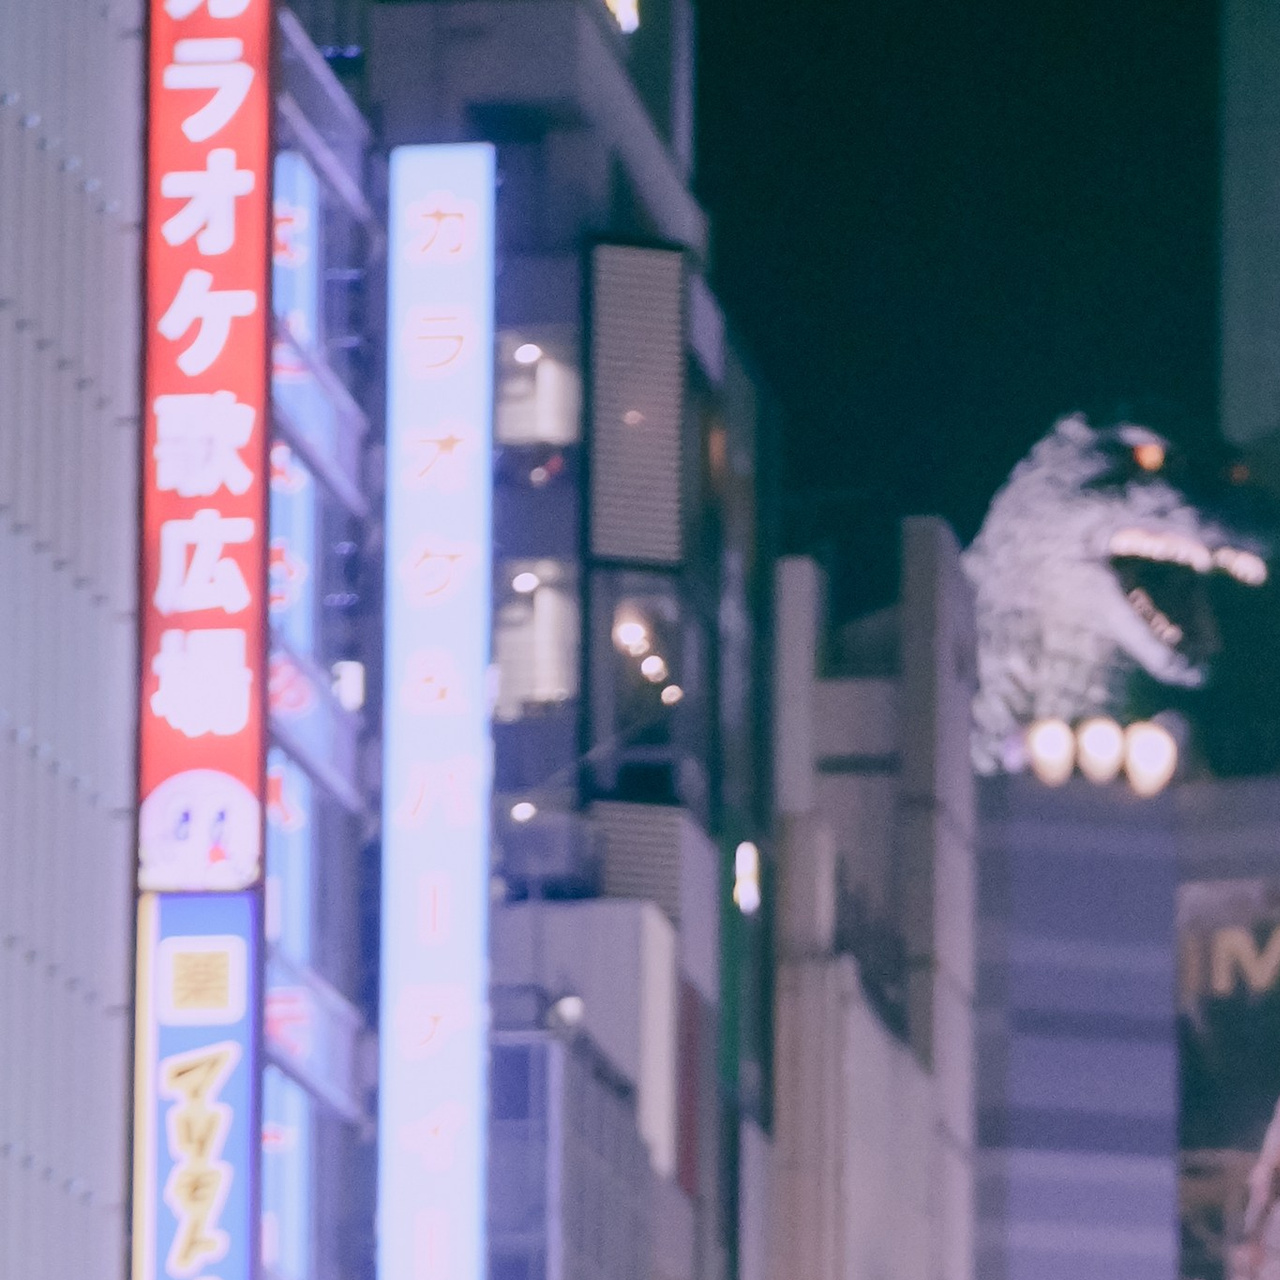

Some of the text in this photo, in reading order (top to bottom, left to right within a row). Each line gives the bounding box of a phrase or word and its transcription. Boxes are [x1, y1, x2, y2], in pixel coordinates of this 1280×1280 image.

[151, 0, 257, 738] ラオケ歌広場
